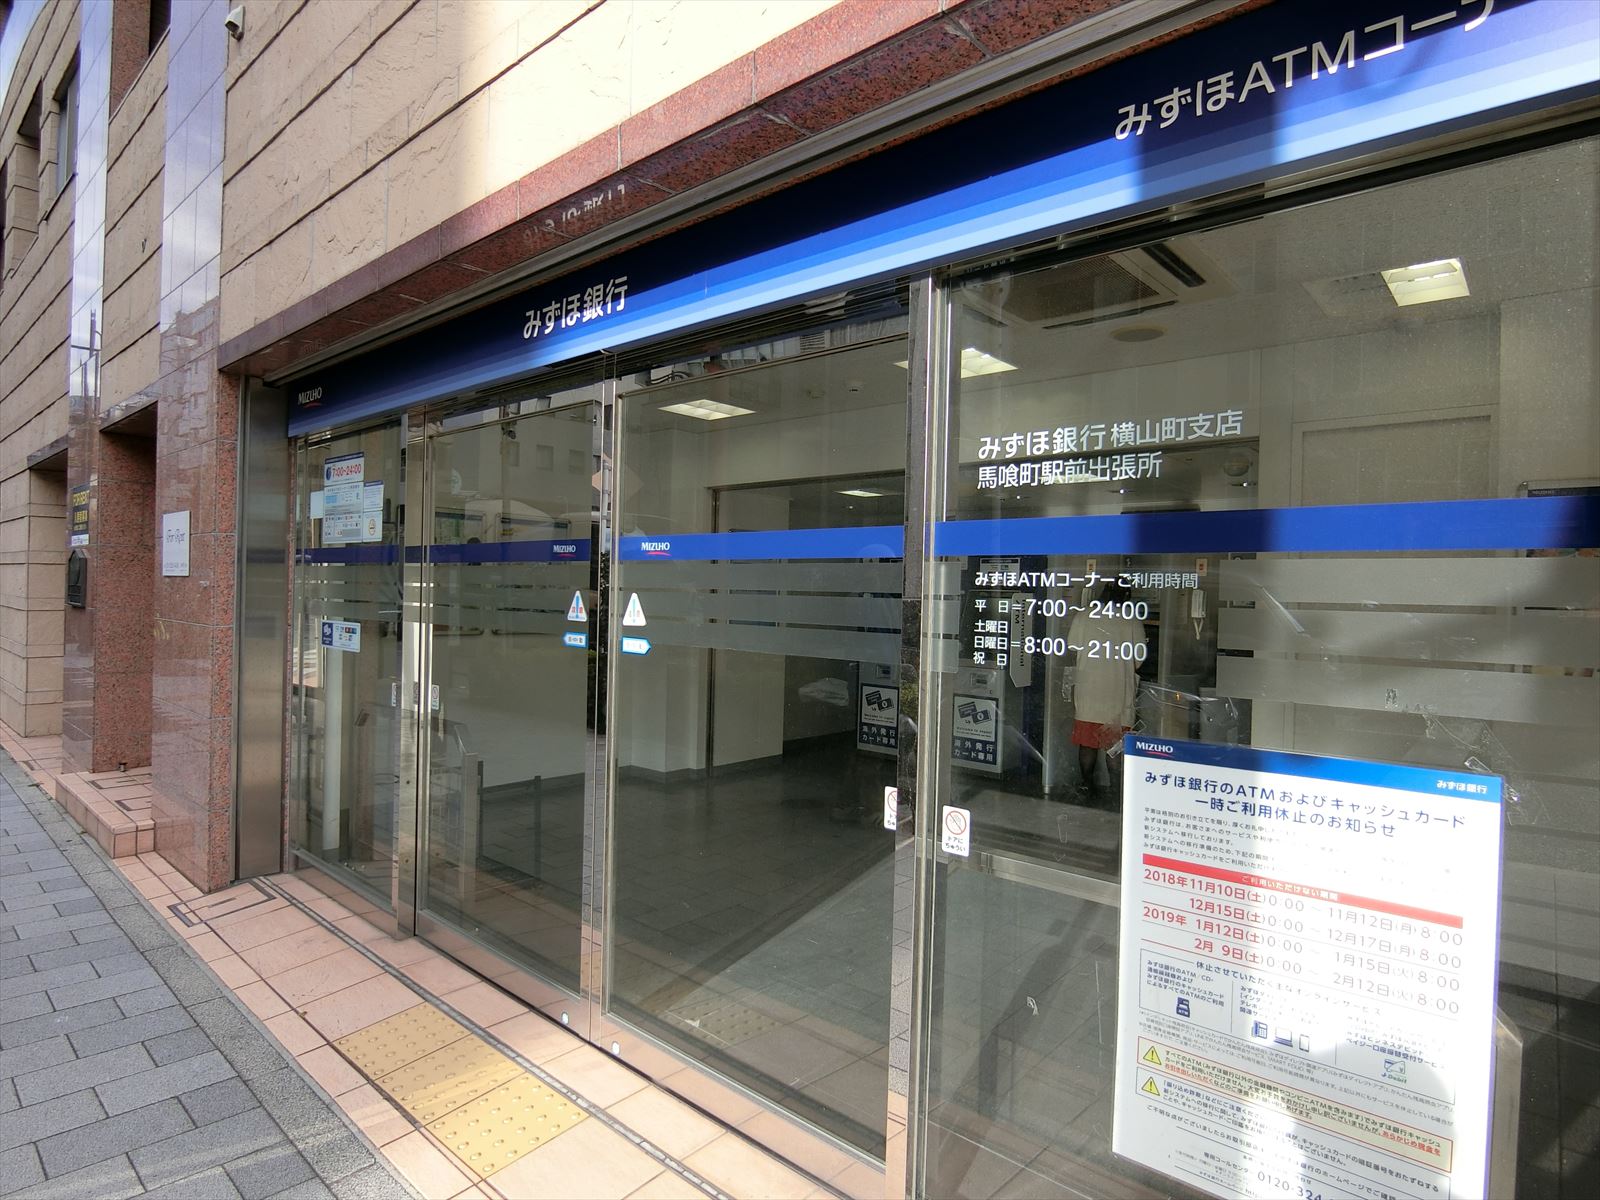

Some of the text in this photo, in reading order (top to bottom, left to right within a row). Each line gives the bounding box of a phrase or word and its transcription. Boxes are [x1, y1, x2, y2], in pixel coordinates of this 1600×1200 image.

[523, 276, 628, 339] みずほ銀行
[298, 387, 323, 405] MIZUHO
[977, 451, 1163, 489] 馬喰町駅前出張所
[553, 544, 577, 553] MIZUHO
[640, 542, 671, 551] MIZUHO
[974, 571, 1199, 590] みずほATMコーナーご利用時間
[973, 620, 1008, 634] 土曜日
[1135, 740, 1174, 754] MIZUHO
[1436, 778, 1488, 795] みずほ銀行
[1195, 793, 1396, 840] 一時ご利用休止のお知らせ
